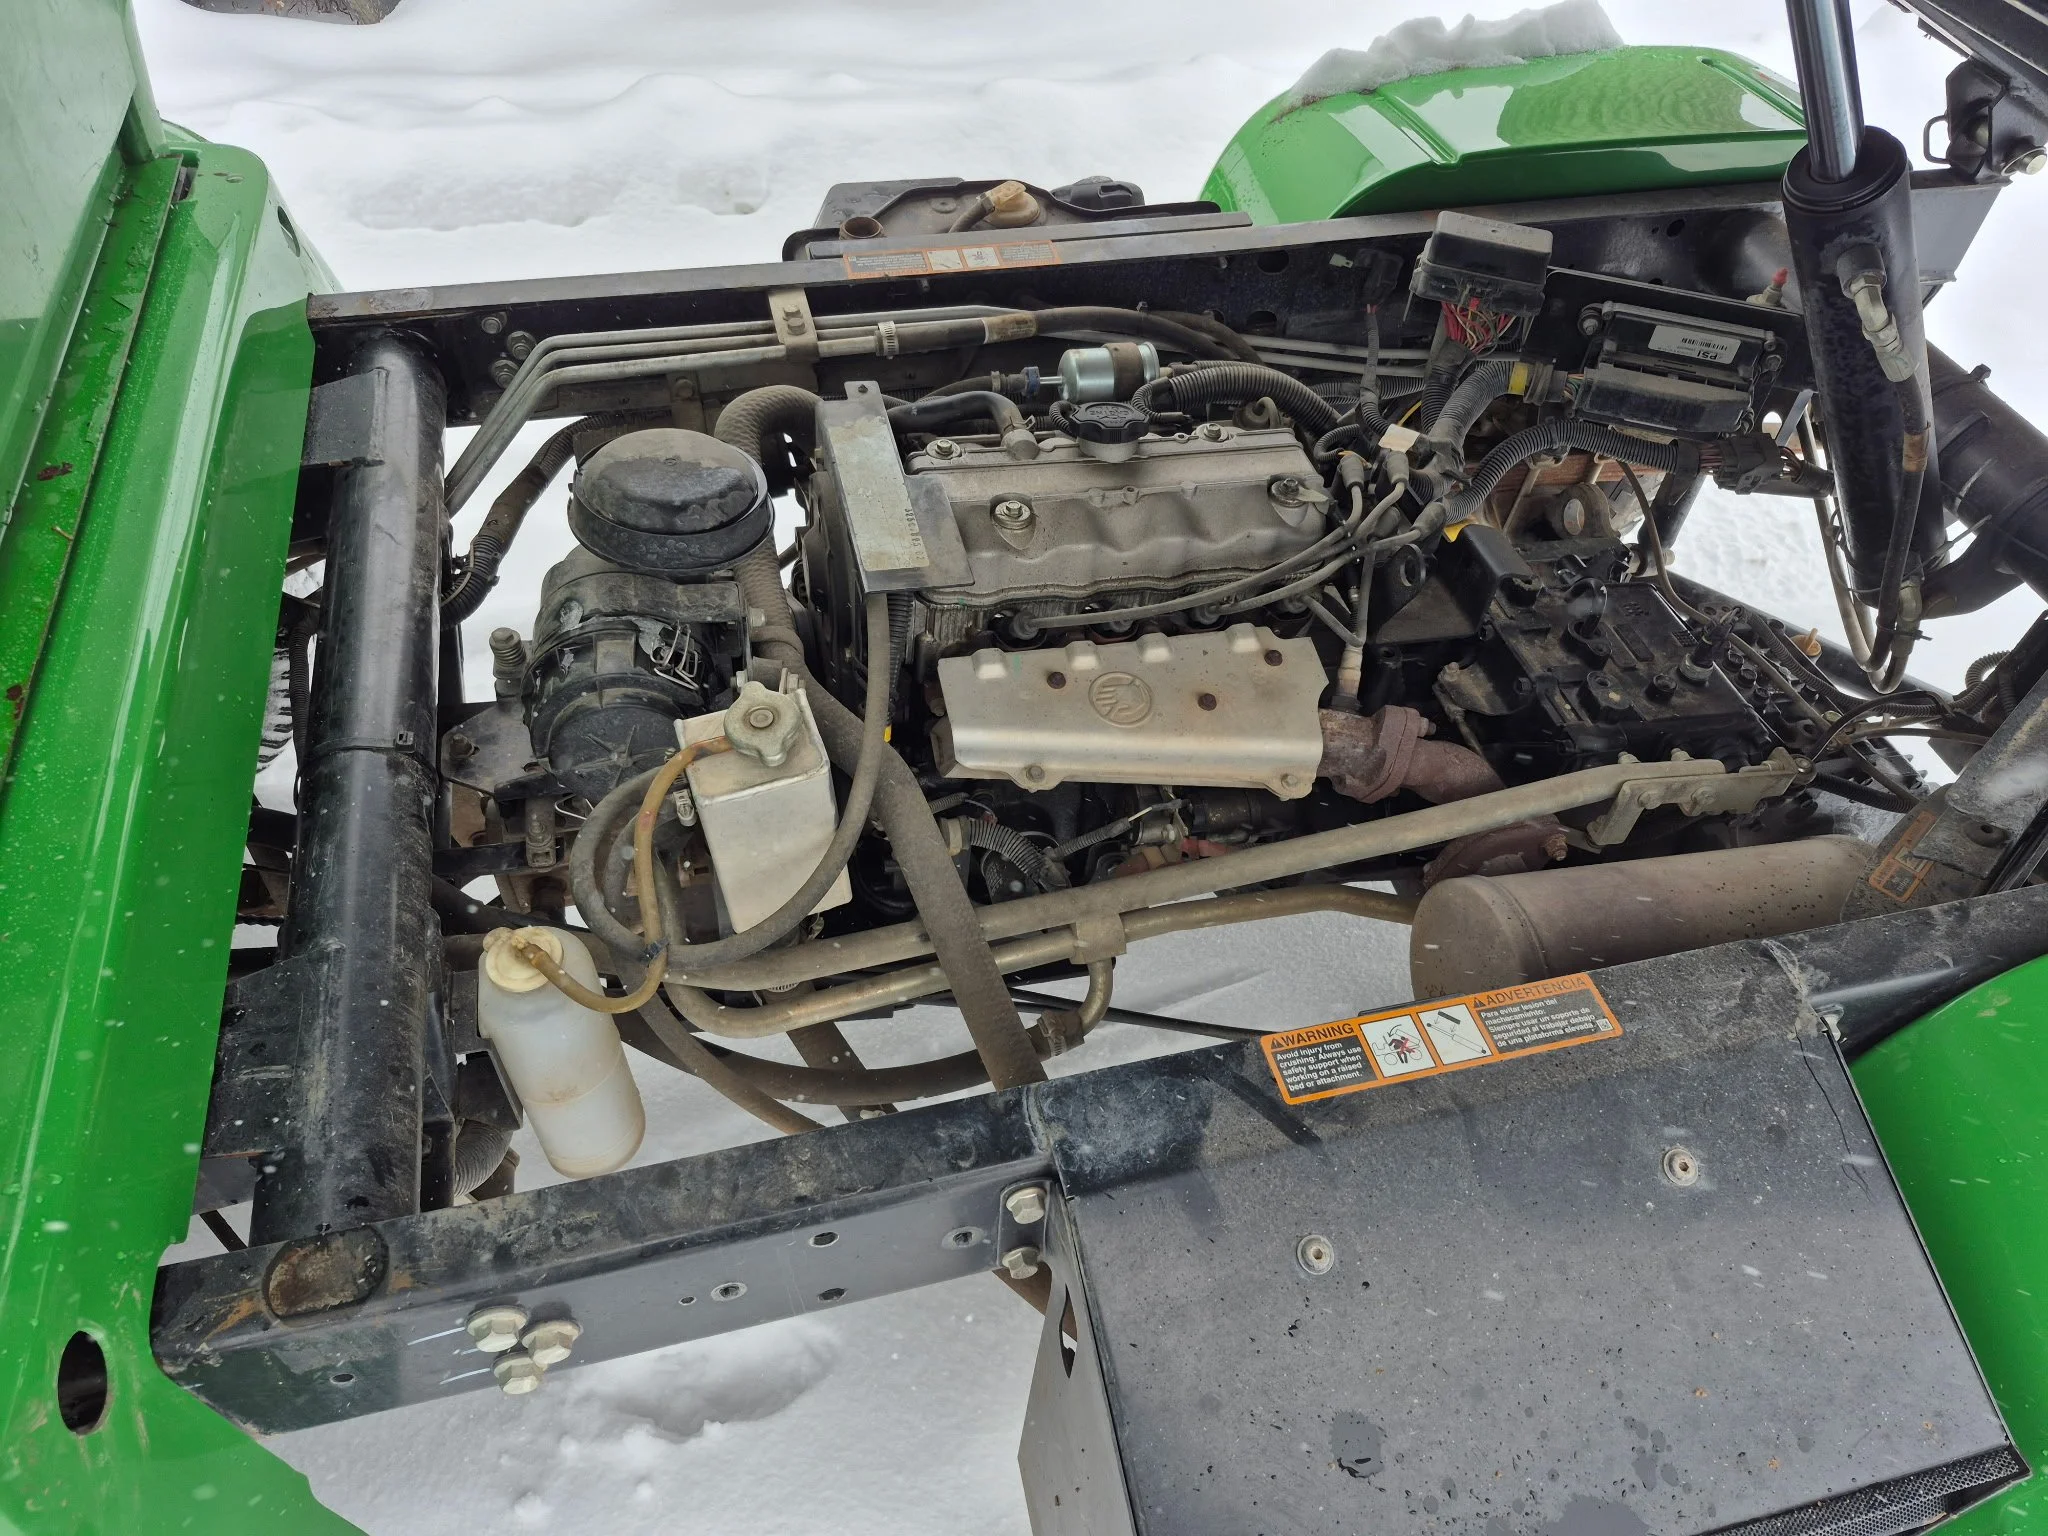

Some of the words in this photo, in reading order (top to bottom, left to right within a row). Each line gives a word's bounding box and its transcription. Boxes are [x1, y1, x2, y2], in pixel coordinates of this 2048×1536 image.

[1697, 350, 1718, 360] PSI
[1487, 977, 1586, 1006] ADVERTENCIA
[1480, 1008, 1498, 1018] Para
[1500, 1006, 1520, 1015] evitar
[1544, 998, 1558, 1006] del
[1488, 1022, 1520, 1033] Siempre
[1522, 1018, 1538, 1027] usar
[1551, 1010, 1580, 1021] soporte
[1580, 1007, 1590, 1015] de
[1492, 1027, 1530, 1041] seguridad
[1532, 1025, 1539, 1033] al
[1540, 1020, 1568, 1032] trabajar
[1570, 1015, 1596, 1026] debajo
[1280, 1022, 1355, 1046] WARNING
[1496, 1040, 1507, 1048] de
[1508, 1037, 1523, 1046] una
[1524, 1028, 1564, 1043] plataforma
[1276, 1050, 1299, 1061] Avoid
[1300, 1046, 1322, 1060] injury
[1324, 1042, 1342, 1051] from
[1280, 1056, 1318, 1068] crushing:
[1318, 1050, 1346, 1060] Always
[1347, 1046, 1362, 1054] use
[1282, 1065, 1307, 1076] safety
[1308, 1058, 1340, 1070] support
[1340, 1054, 1362, 1064] when
[1285, 1072, 1318, 1084] working
[1338, 1062, 1362, 1073] raised
[1288, 1080, 1305, 1092] bed
[1316, 1072, 1363, 1086] attachment.
